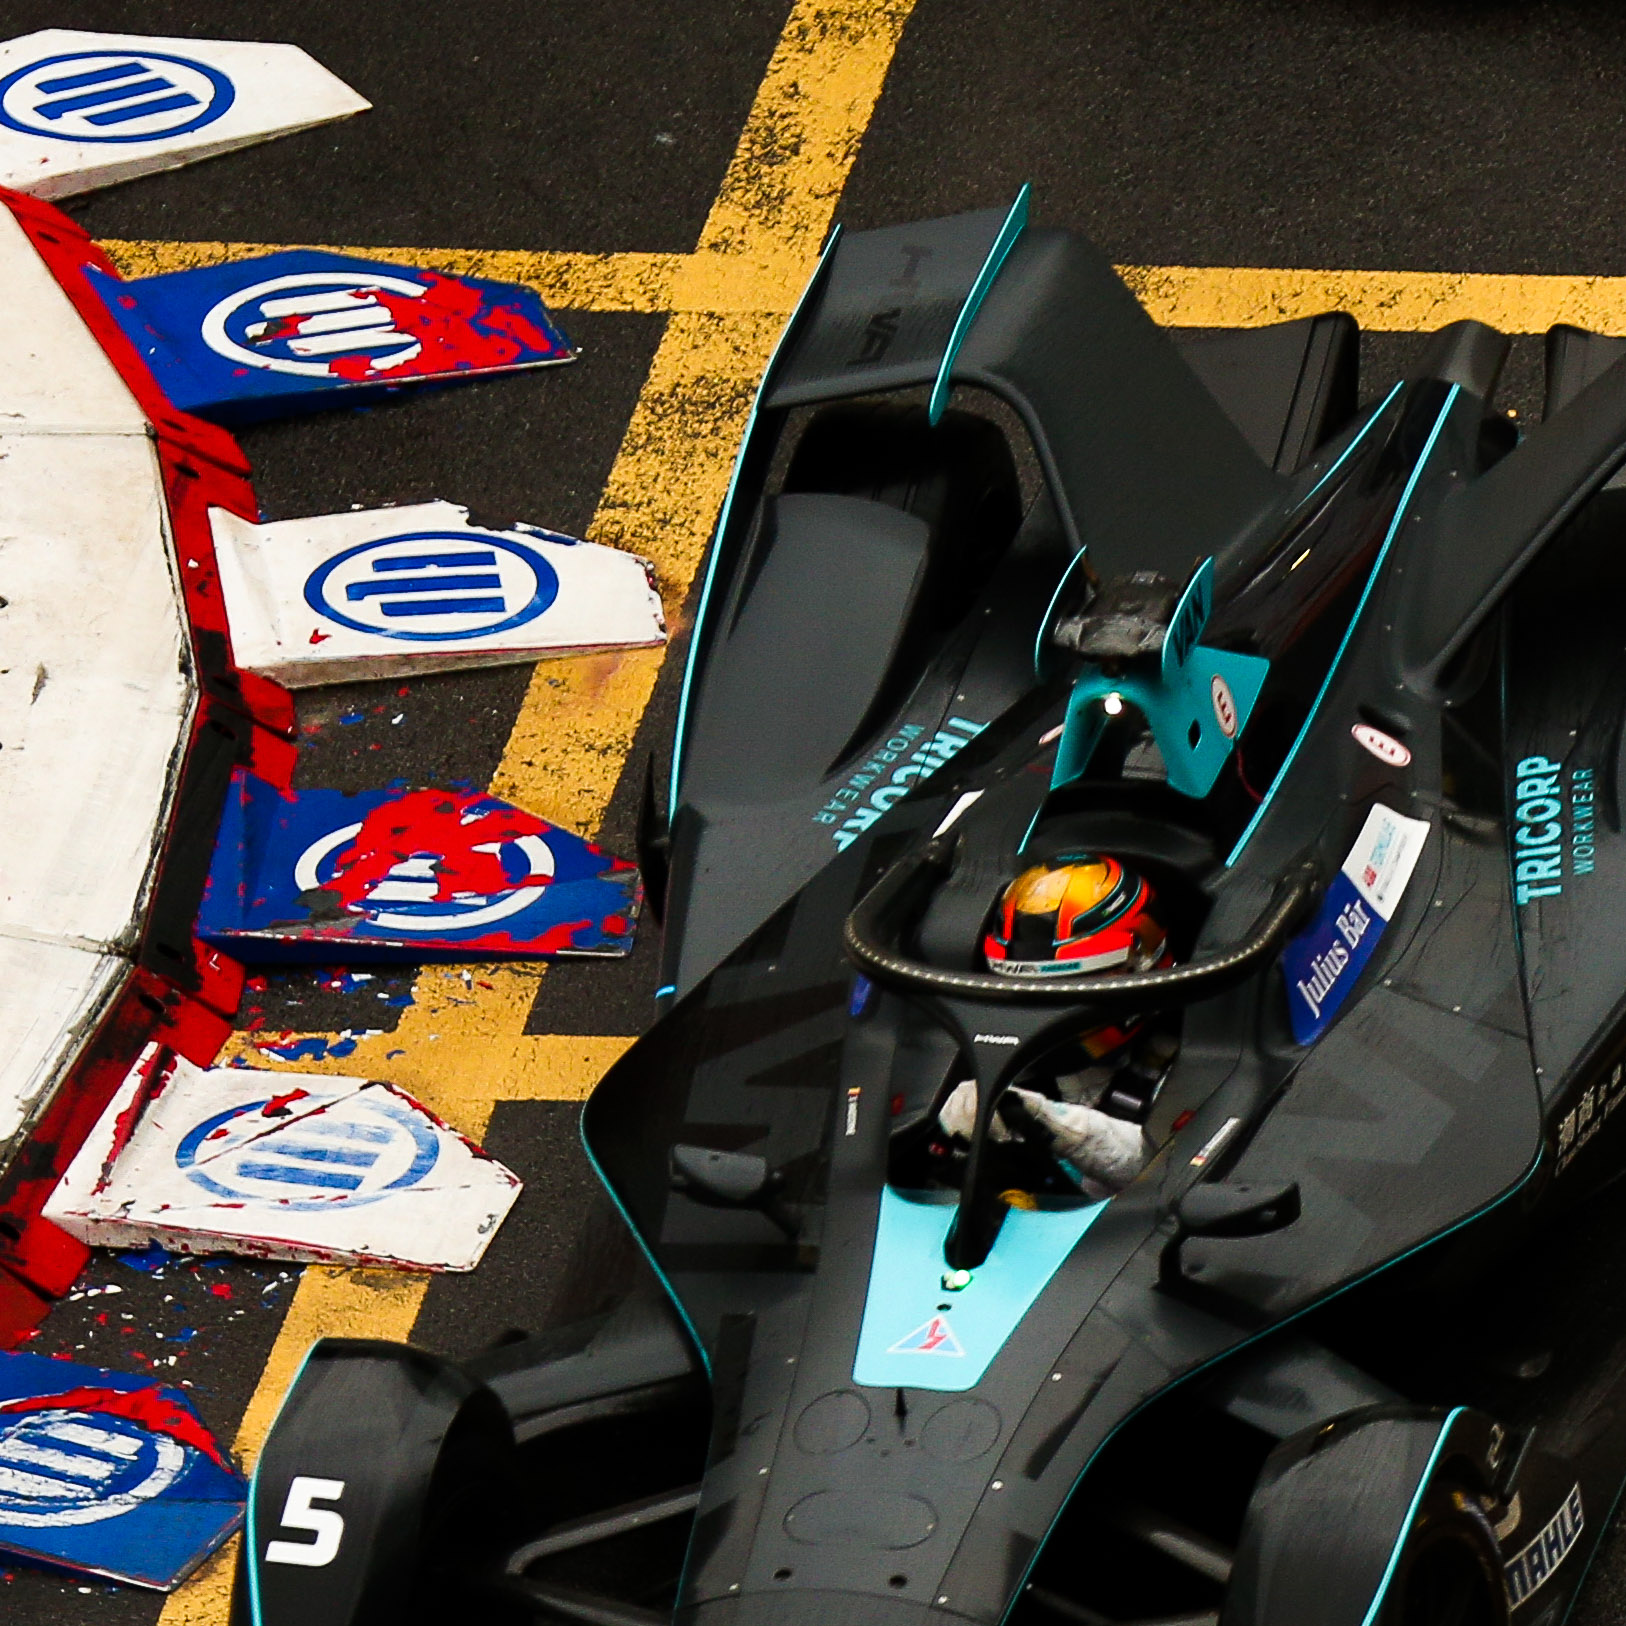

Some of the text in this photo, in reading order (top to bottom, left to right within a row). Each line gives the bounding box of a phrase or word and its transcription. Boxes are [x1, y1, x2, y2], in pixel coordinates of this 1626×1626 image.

[811, 723, 926, 825] WORKWEAR
[1571, 767, 1595, 876] WORKWEAR
[1515, 755, 1562, 906] TRICORP
[1296, 899, 1371, 1019] Julius Bär
[265, 1476, 345, 1567] 5
